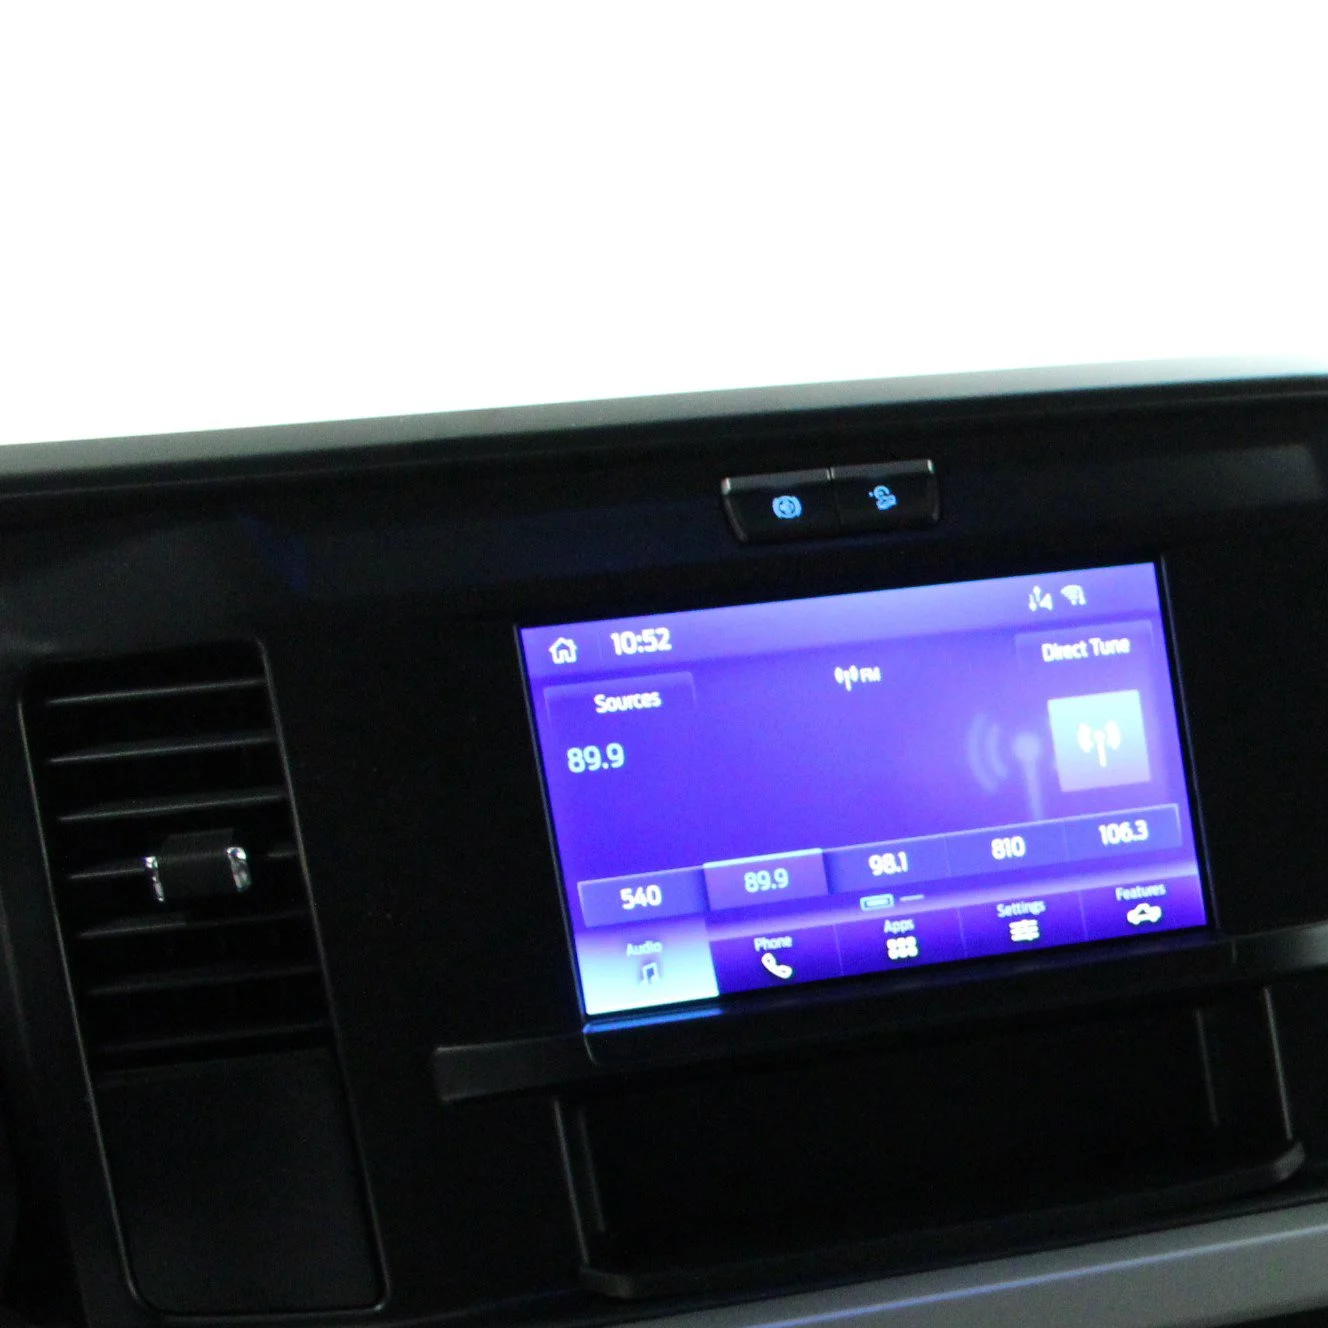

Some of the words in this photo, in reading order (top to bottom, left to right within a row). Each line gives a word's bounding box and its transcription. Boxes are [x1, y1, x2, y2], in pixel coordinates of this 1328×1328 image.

[610, 627, 672, 656] 10:52
[1041, 640, 1088, 662] Direct
[1088, 637, 1131, 657] Tune
[593, 691, 662, 714] Sources
[566, 742, 625, 773] 89.9
[620, 884, 662, 910] 540
[744, 868, 789, 893] 89.9
[868, 851, 909, 876] 98.1
[991, 836, 1026, 860] 810
[1098, 819, 1149, 845] 106.3
[626, 940, 663, 957] Audio
[754, 936, 793, 951] Phone
[884, 919, 915, 934] Apps
[996, 901, 1046, 918] Settings
[1115, 884, 1167, 901] Features
